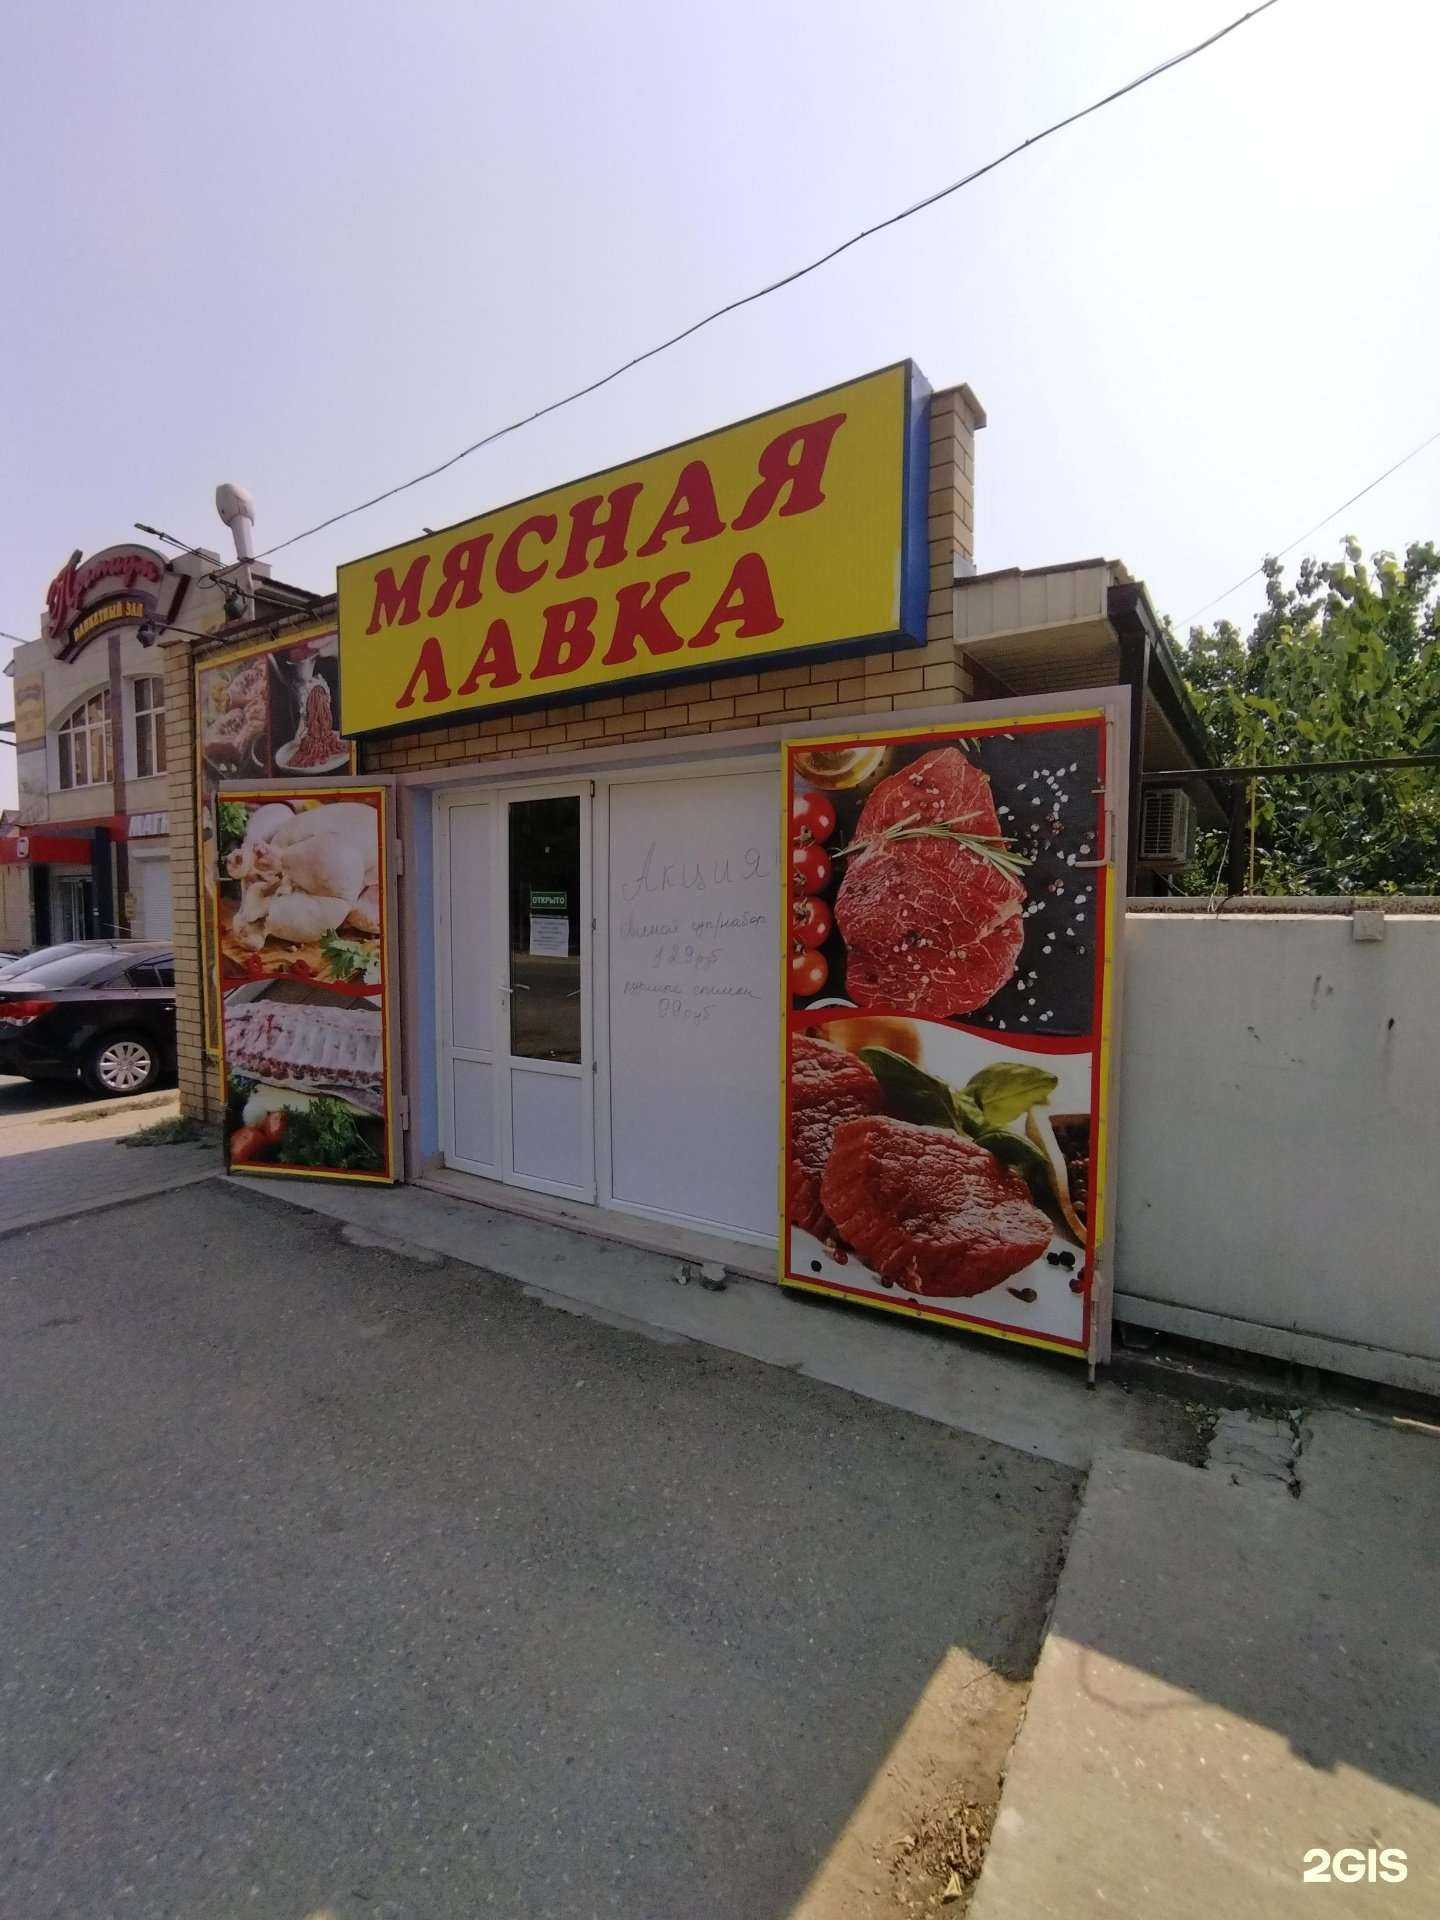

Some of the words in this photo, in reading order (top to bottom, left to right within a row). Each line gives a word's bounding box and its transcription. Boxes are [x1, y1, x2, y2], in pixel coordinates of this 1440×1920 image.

[366, 413, 847, 635] МЯСНАЯ
[395, 552, 784, 709] ЛАВКА
[532, 896, 565, 905] ОТКРЫТО
